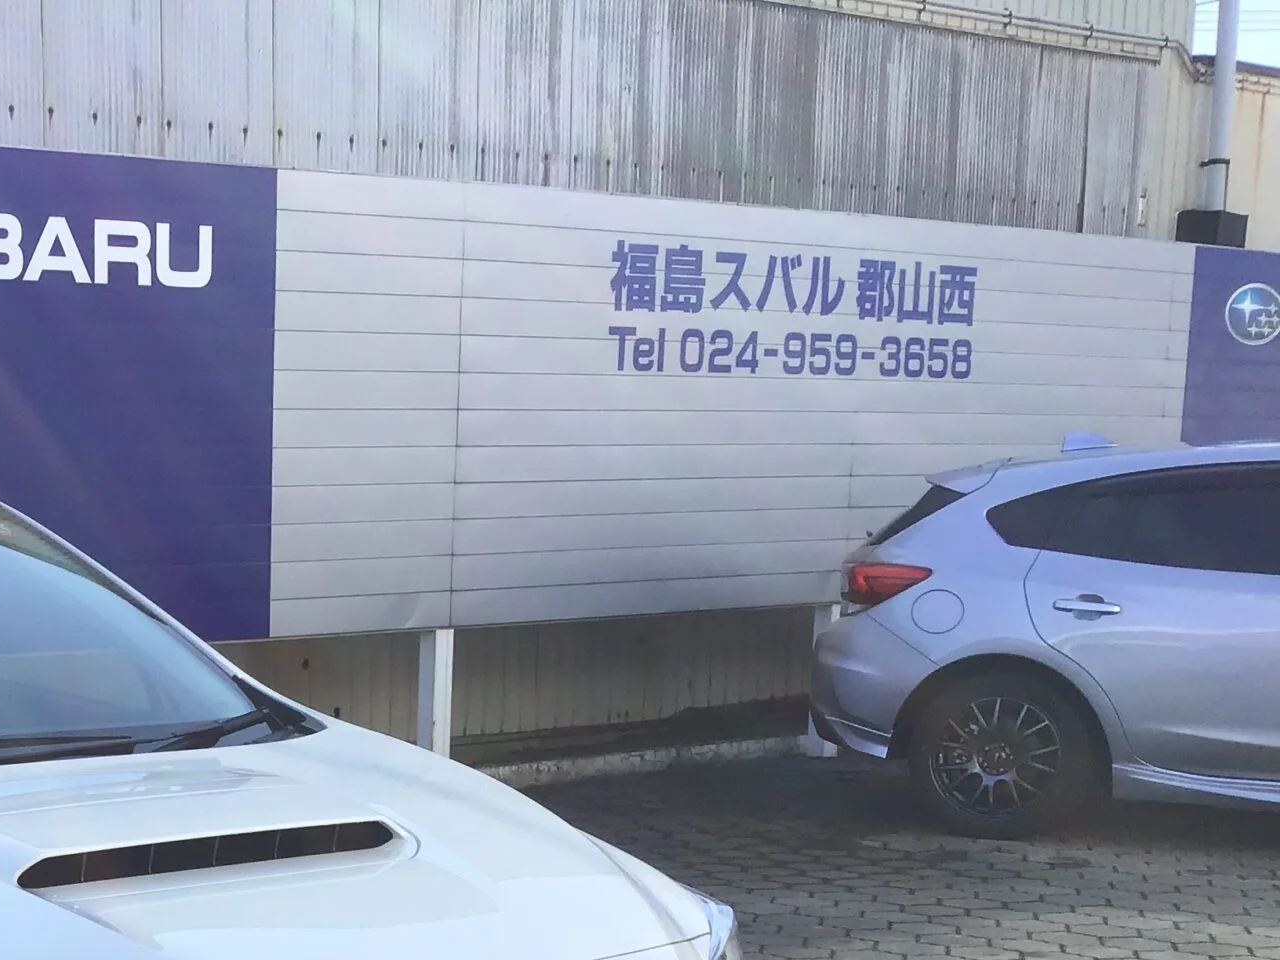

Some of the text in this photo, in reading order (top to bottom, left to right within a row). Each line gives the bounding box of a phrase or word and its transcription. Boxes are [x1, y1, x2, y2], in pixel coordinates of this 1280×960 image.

[609, 239, 978, 327] 福島スバル 郡山西
[608, 326, 973, 380] Tel 024-959-3658
